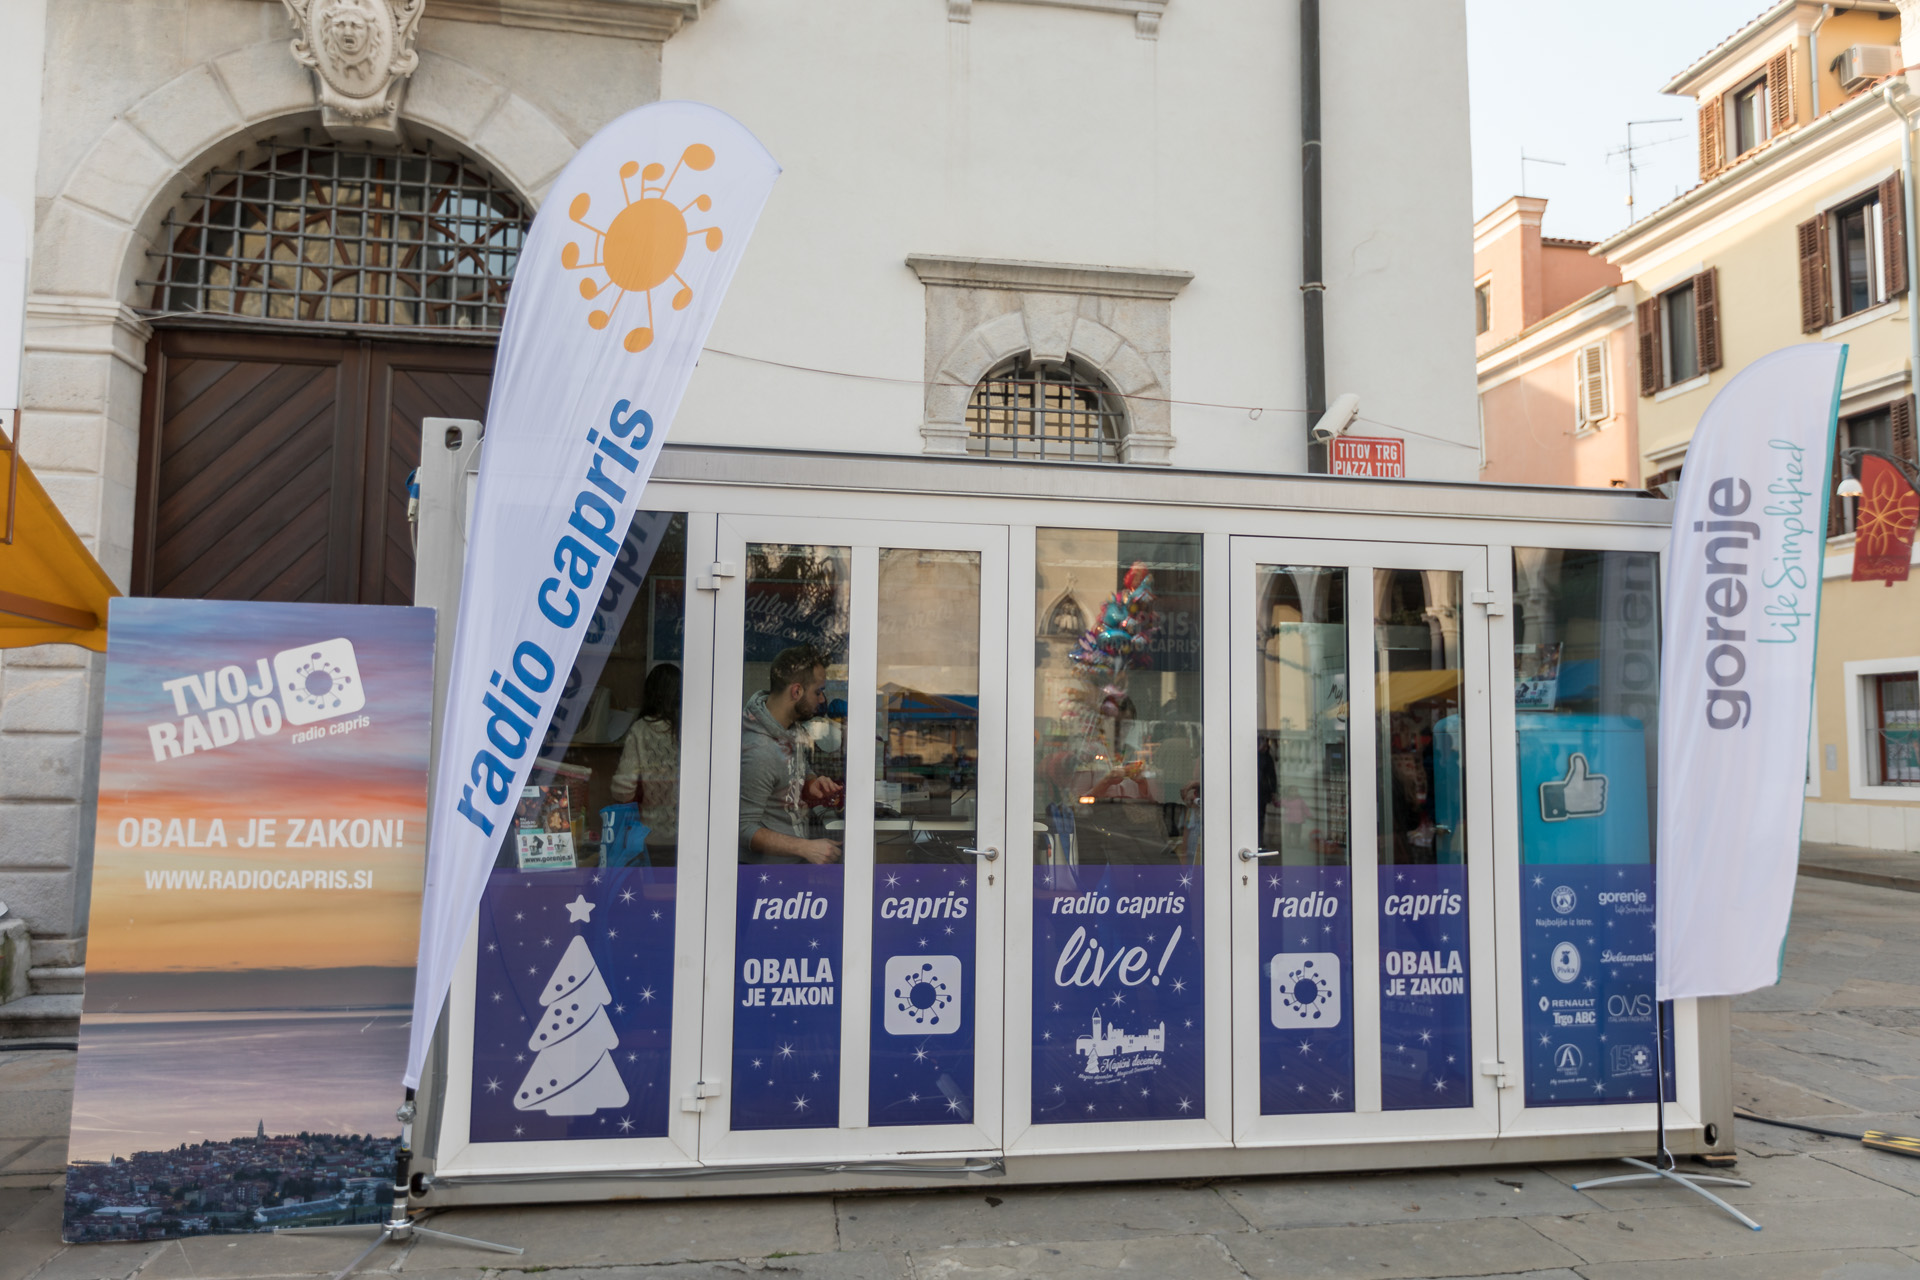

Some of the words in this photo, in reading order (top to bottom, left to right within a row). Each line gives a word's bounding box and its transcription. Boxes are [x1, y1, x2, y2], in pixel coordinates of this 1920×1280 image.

[1338, 443, 1370, 459] TITOV
[1376, 445, 1397, 460] TRG
[1335, 461, 1372, 476] PIAZZA
[1376, 462, 1400, 478] TITO
[1761, 438, 1813, 589] Simplified
[1693, 475, 1760, 731] gorenje
[457, 640, 555, 838] radio
[537, 398, 655, 630] capris
[1757, 593, 1811, 645] Life
[162, 658, 274, 717] TVOJ
[148, 698, 282, 763] RADIO
[292, 724, 326, 745] radio
[330, 714, 370, 738] capris
[118, 817, 228, 848] OBALA
[237, 818, 276, 848] JE
[286, 818, 405, 848] ZAKON!
[145, 870, 373, 889] WWW.RADIOCAPRIS.SI
[752, 891, 828, 920] radio
[881, 891, 969, 925] capris
[1052, 892, 1110, 914] radio
[1116, 892, 1185, 919] capris
[1272, 891, 1338, 918] radio
[1384, 889, 1462, 921] capris
[1598, 889, 1647, 906] gorenje
[1536, 918, 1568, 928] Najboljše
[1569, 918, 1575, 926] iz
[1054, 925, 1182, 987] live!
[1385, 951, 1463, 975] OBALA
[743, 958, 834, 984] OBALA
[1557, 966, 1576, 975] Pivka
[742, 988, 766, 1007] JE
[771, 986, 834, 1006] ZAKON
[1385, 979, 1405, 996] JE
[1410, 977, 1464, 996] ZAKON
[1552, 999, 1595, 1008] RENAULT
[1608, 994, 1652, 1016] OVS
[1552, 1012, 1573, 1026] Trgo
[1575, 1011, 1596, 1024] ABC
